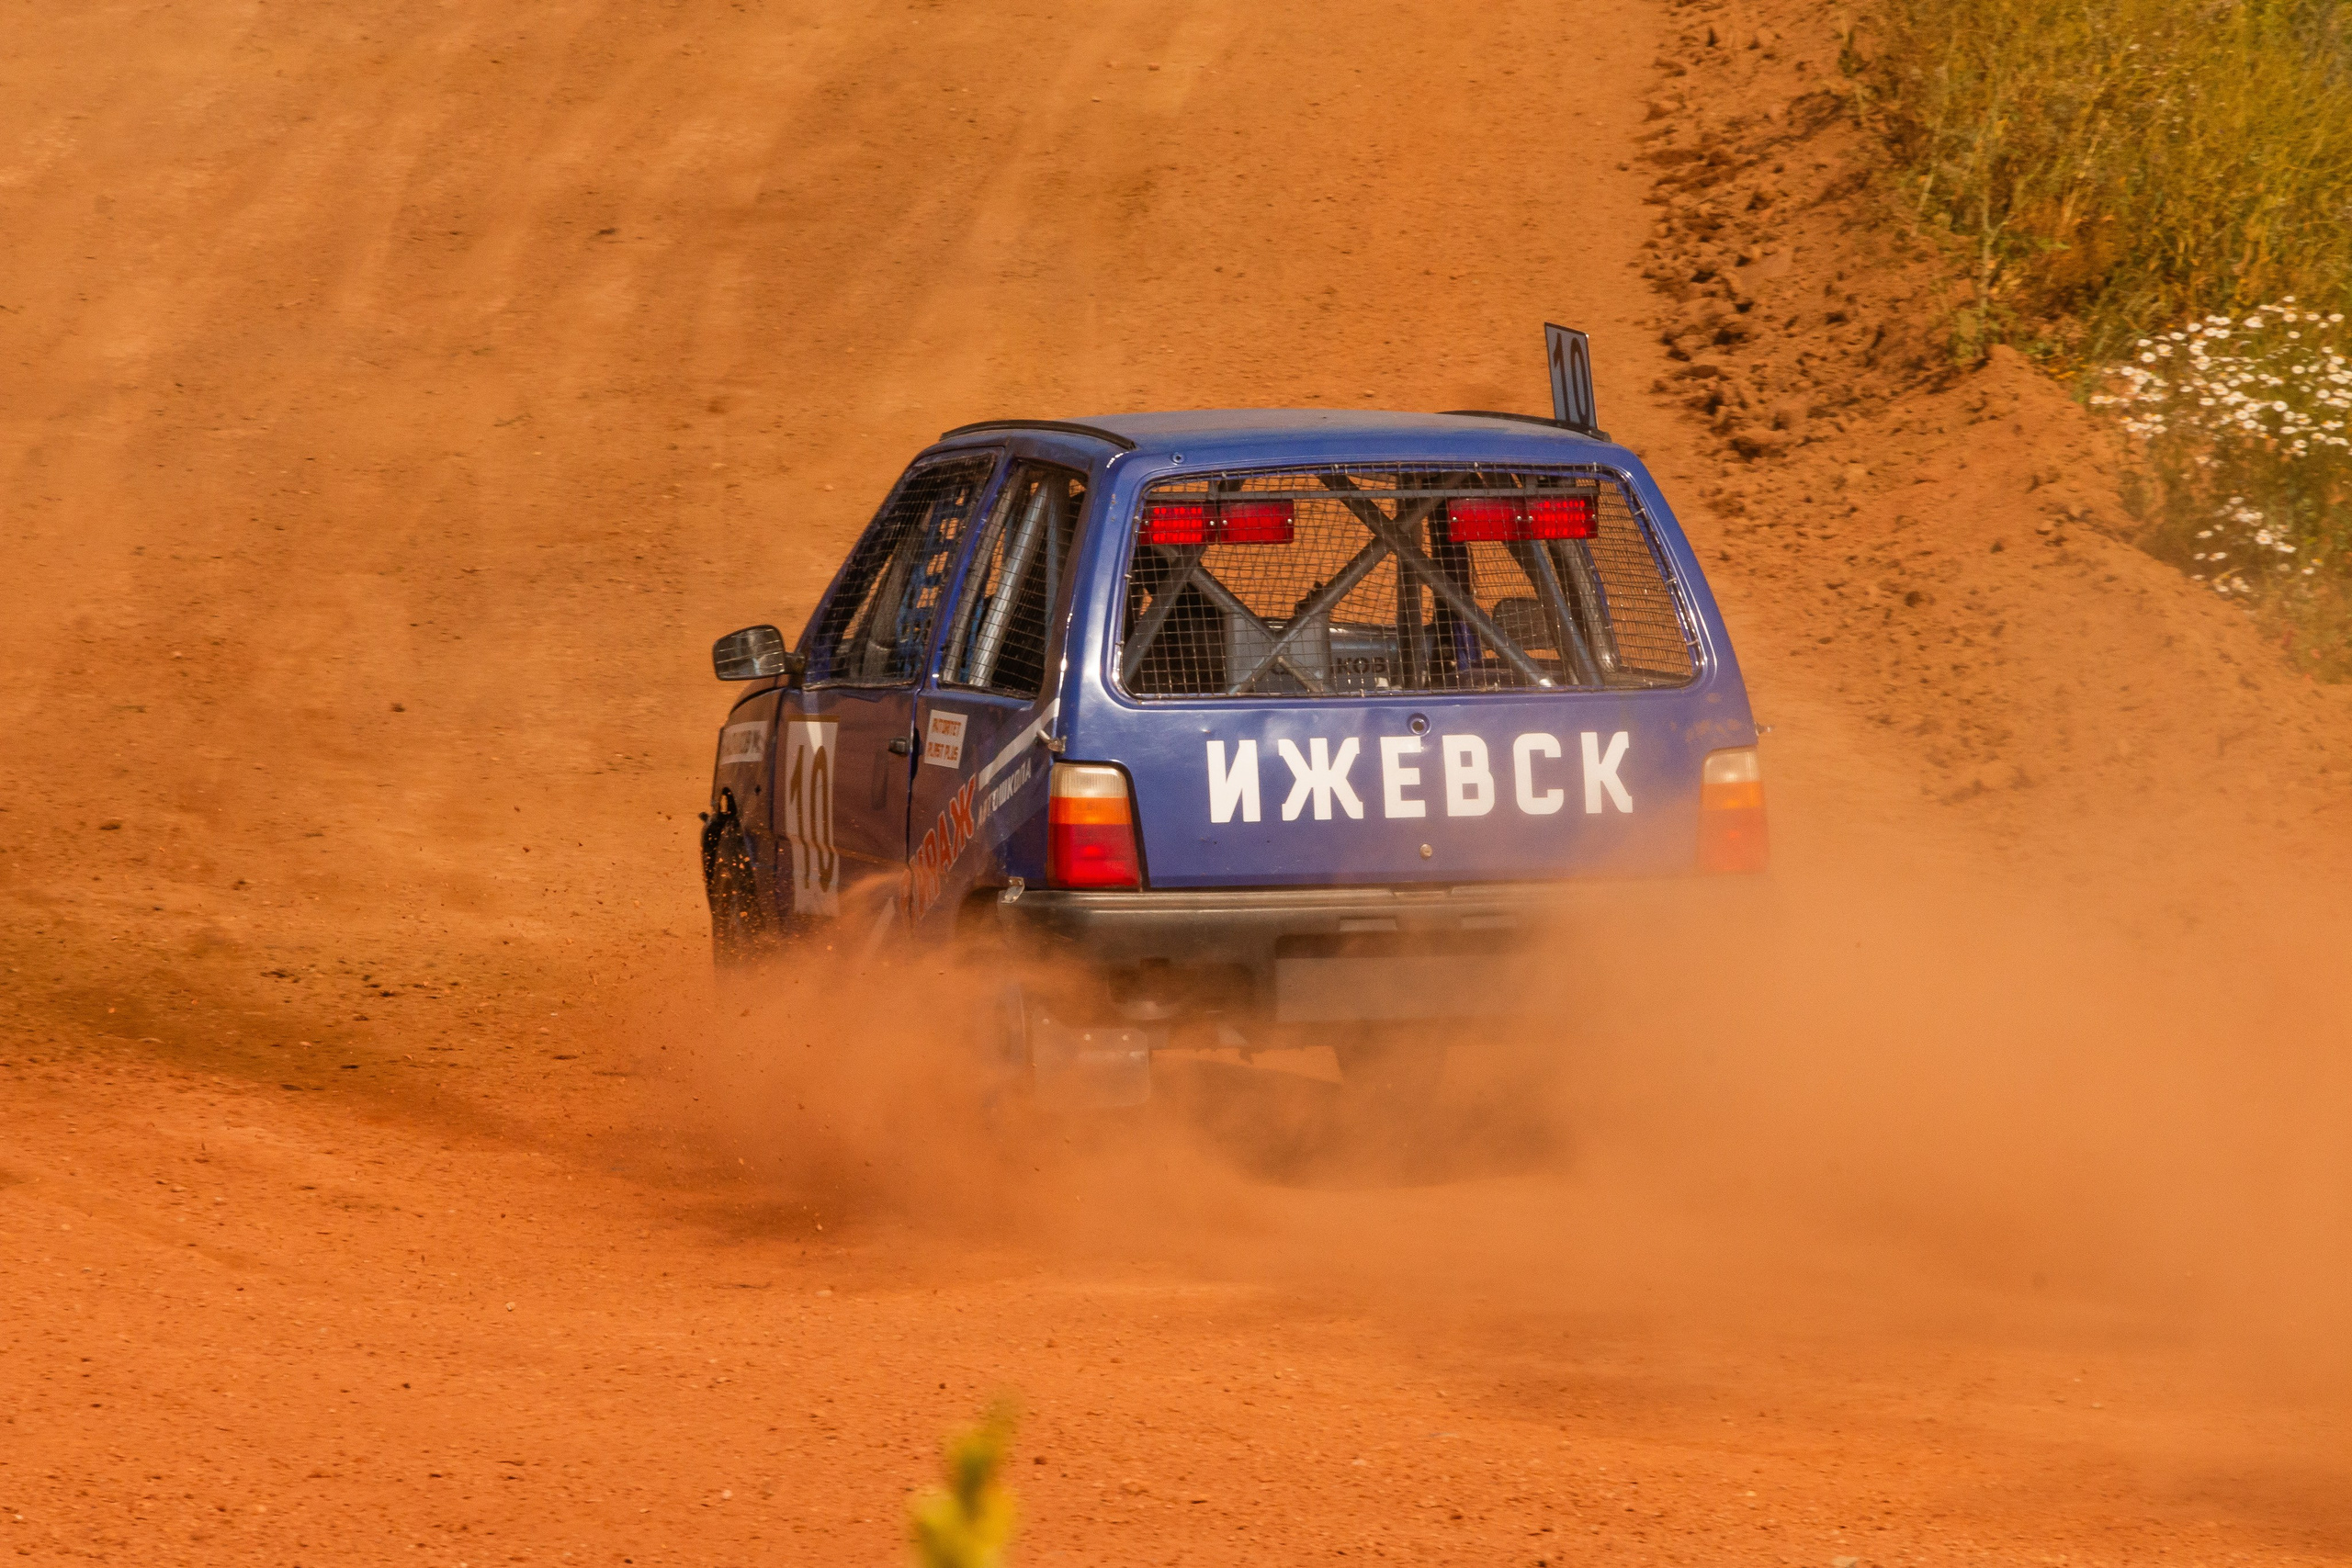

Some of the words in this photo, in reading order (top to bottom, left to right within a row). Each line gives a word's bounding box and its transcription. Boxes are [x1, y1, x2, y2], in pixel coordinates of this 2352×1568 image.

[1553, 332, 1589, 424] 10
[790, 745, 834, 893] 10
[1205, 731, 1634, 823] ИЖЕВСК
